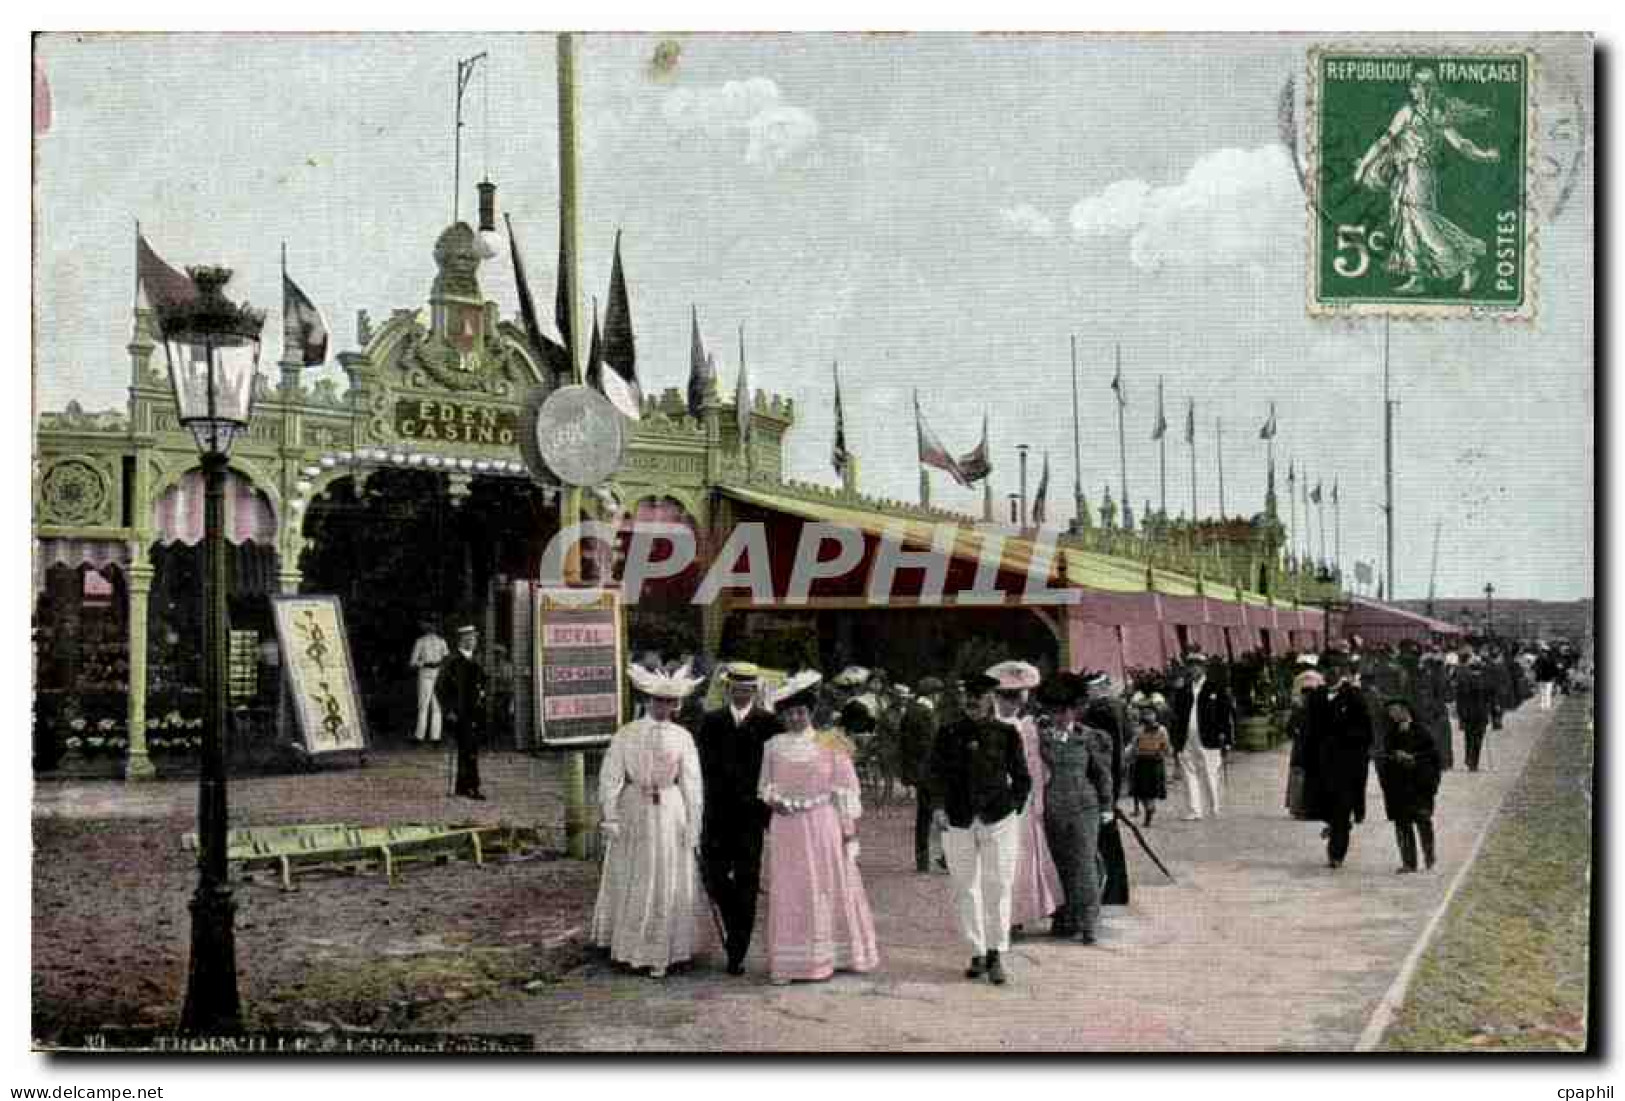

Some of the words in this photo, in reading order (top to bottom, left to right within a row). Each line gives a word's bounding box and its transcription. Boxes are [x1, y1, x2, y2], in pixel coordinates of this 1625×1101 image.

[1438, 61, 1519, 84] FRANÇAISE
[1495, 210, 1517, 291] POSTES
[419, 401, 498, 426] EDEN
[402, 419, 514, 444] CASINO
